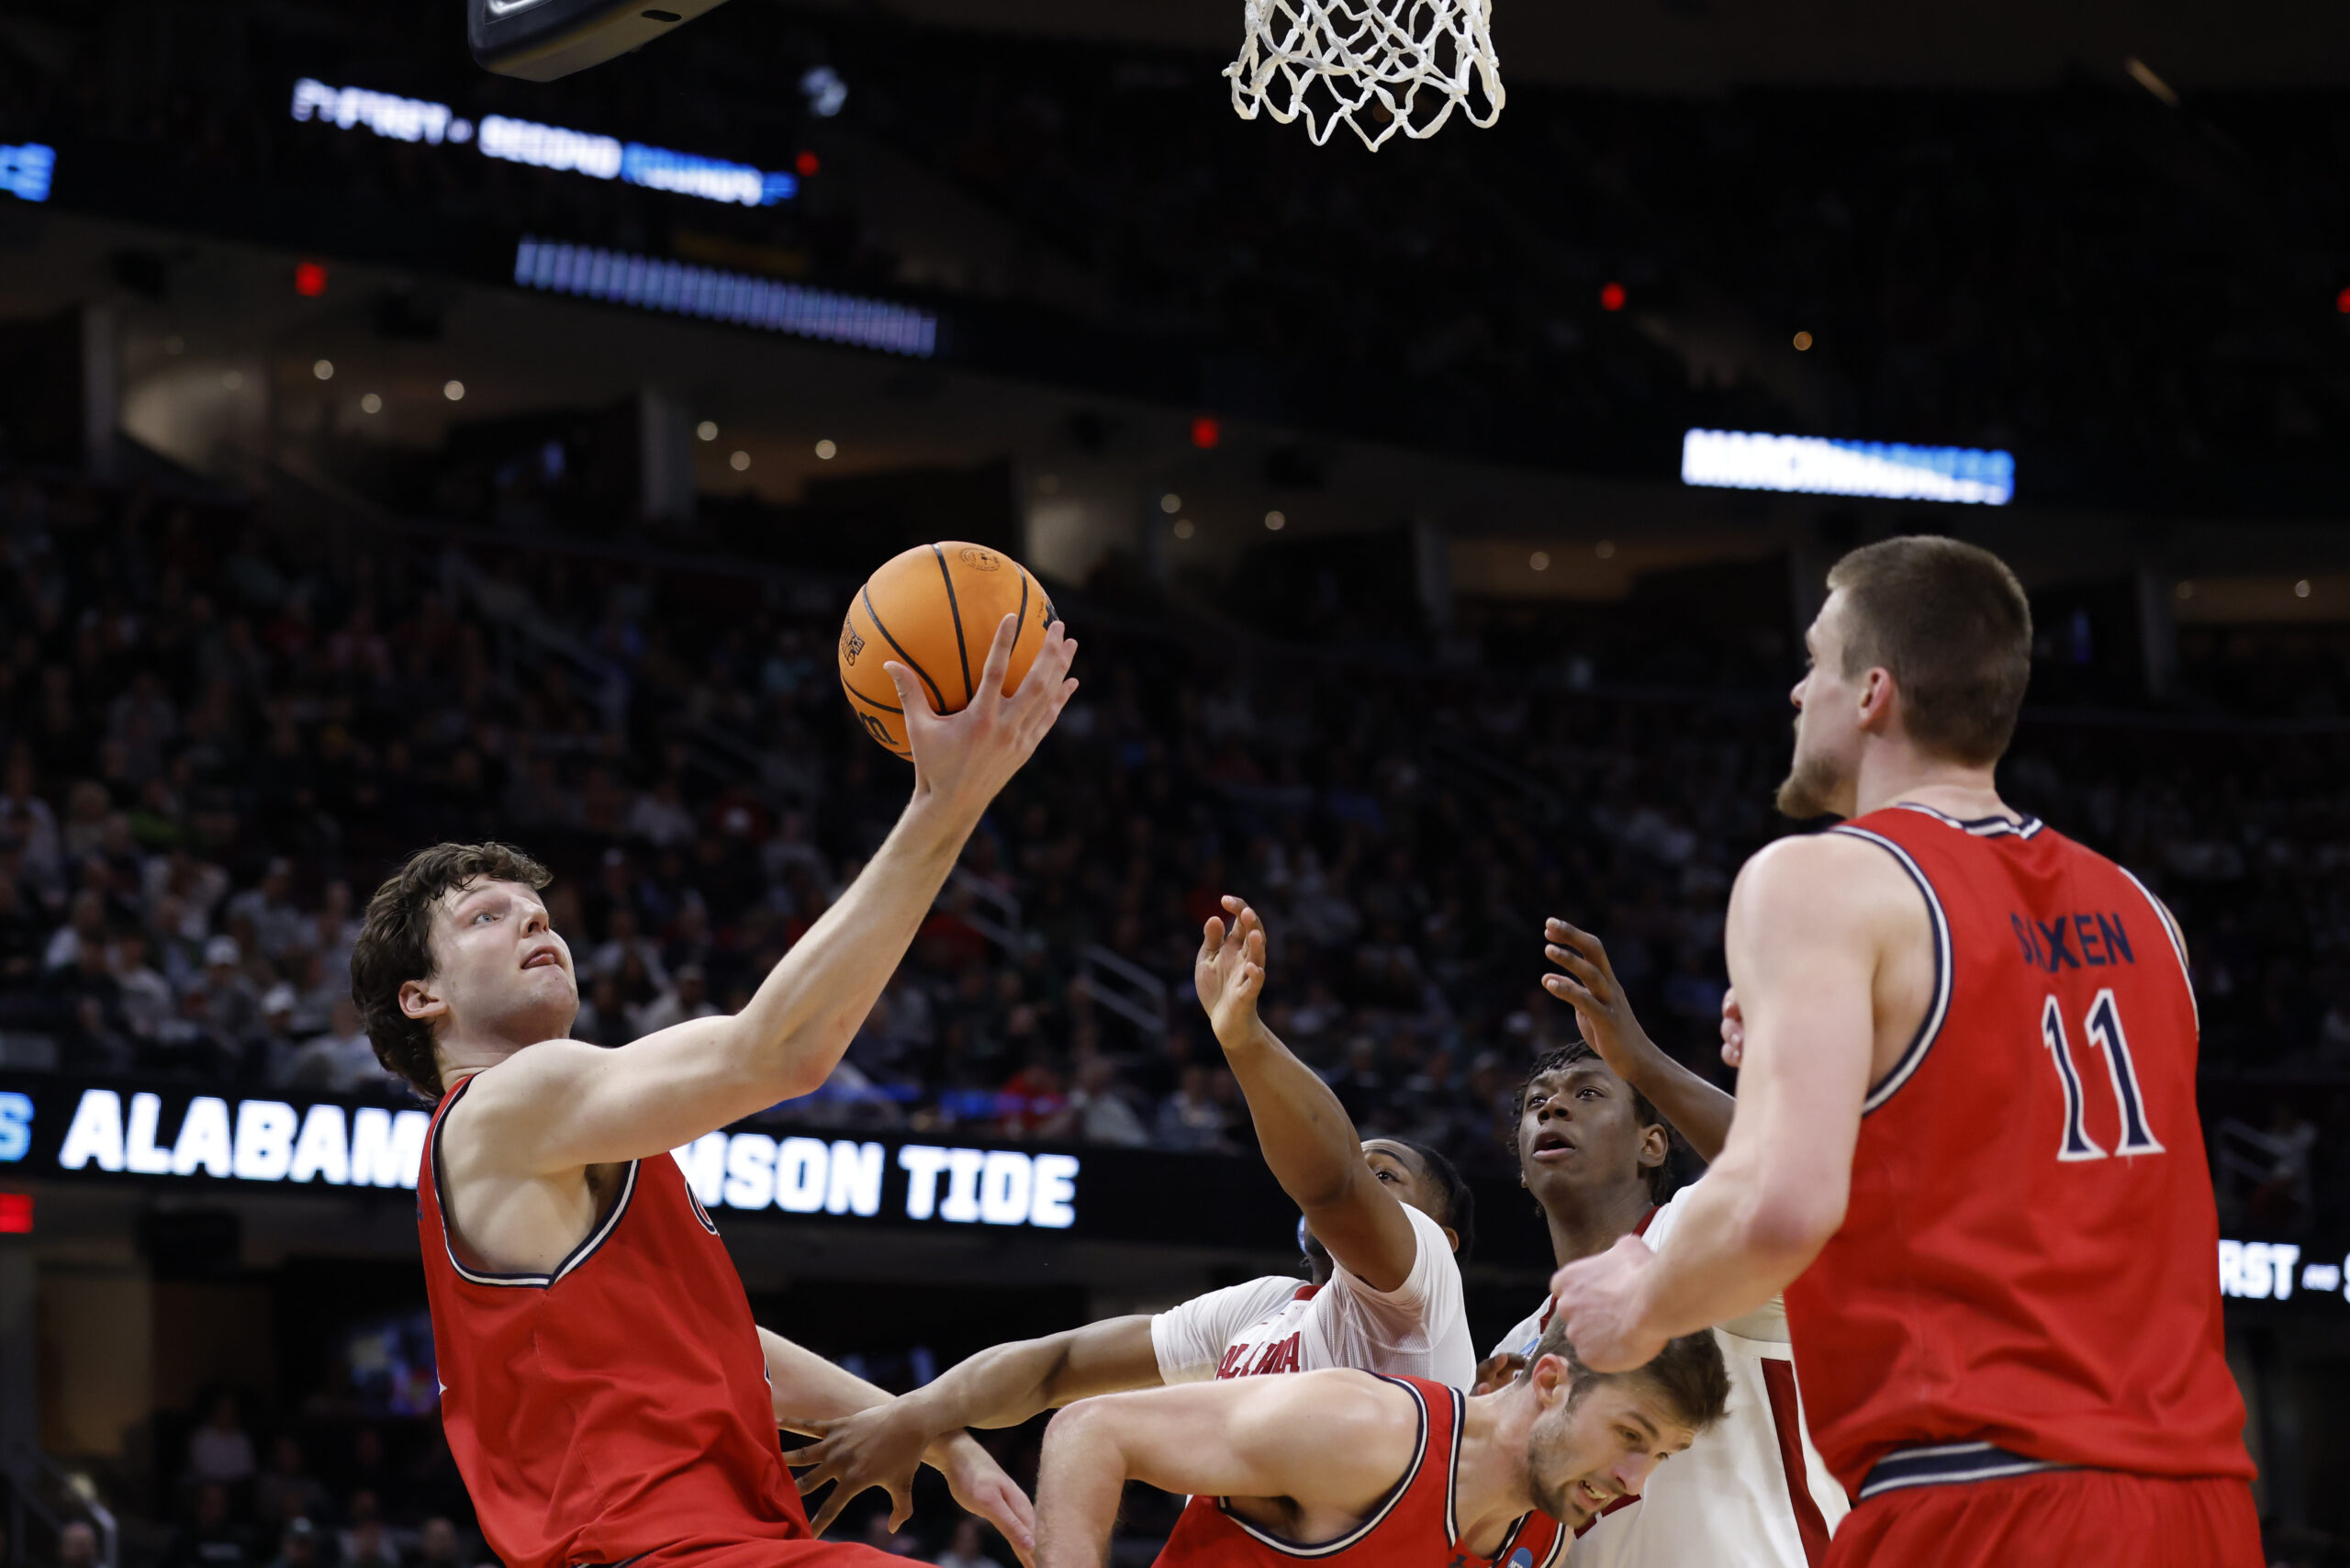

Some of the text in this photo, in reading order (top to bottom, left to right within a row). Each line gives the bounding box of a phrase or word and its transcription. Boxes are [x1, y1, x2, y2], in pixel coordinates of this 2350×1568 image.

[2041, 989, 2166, 1162] 11
[58, 1089, 432, 1191] ALABAM
[898, 1143, 1080, 1228] TIDE
[2218, 1238, 2301, 1301] RST
